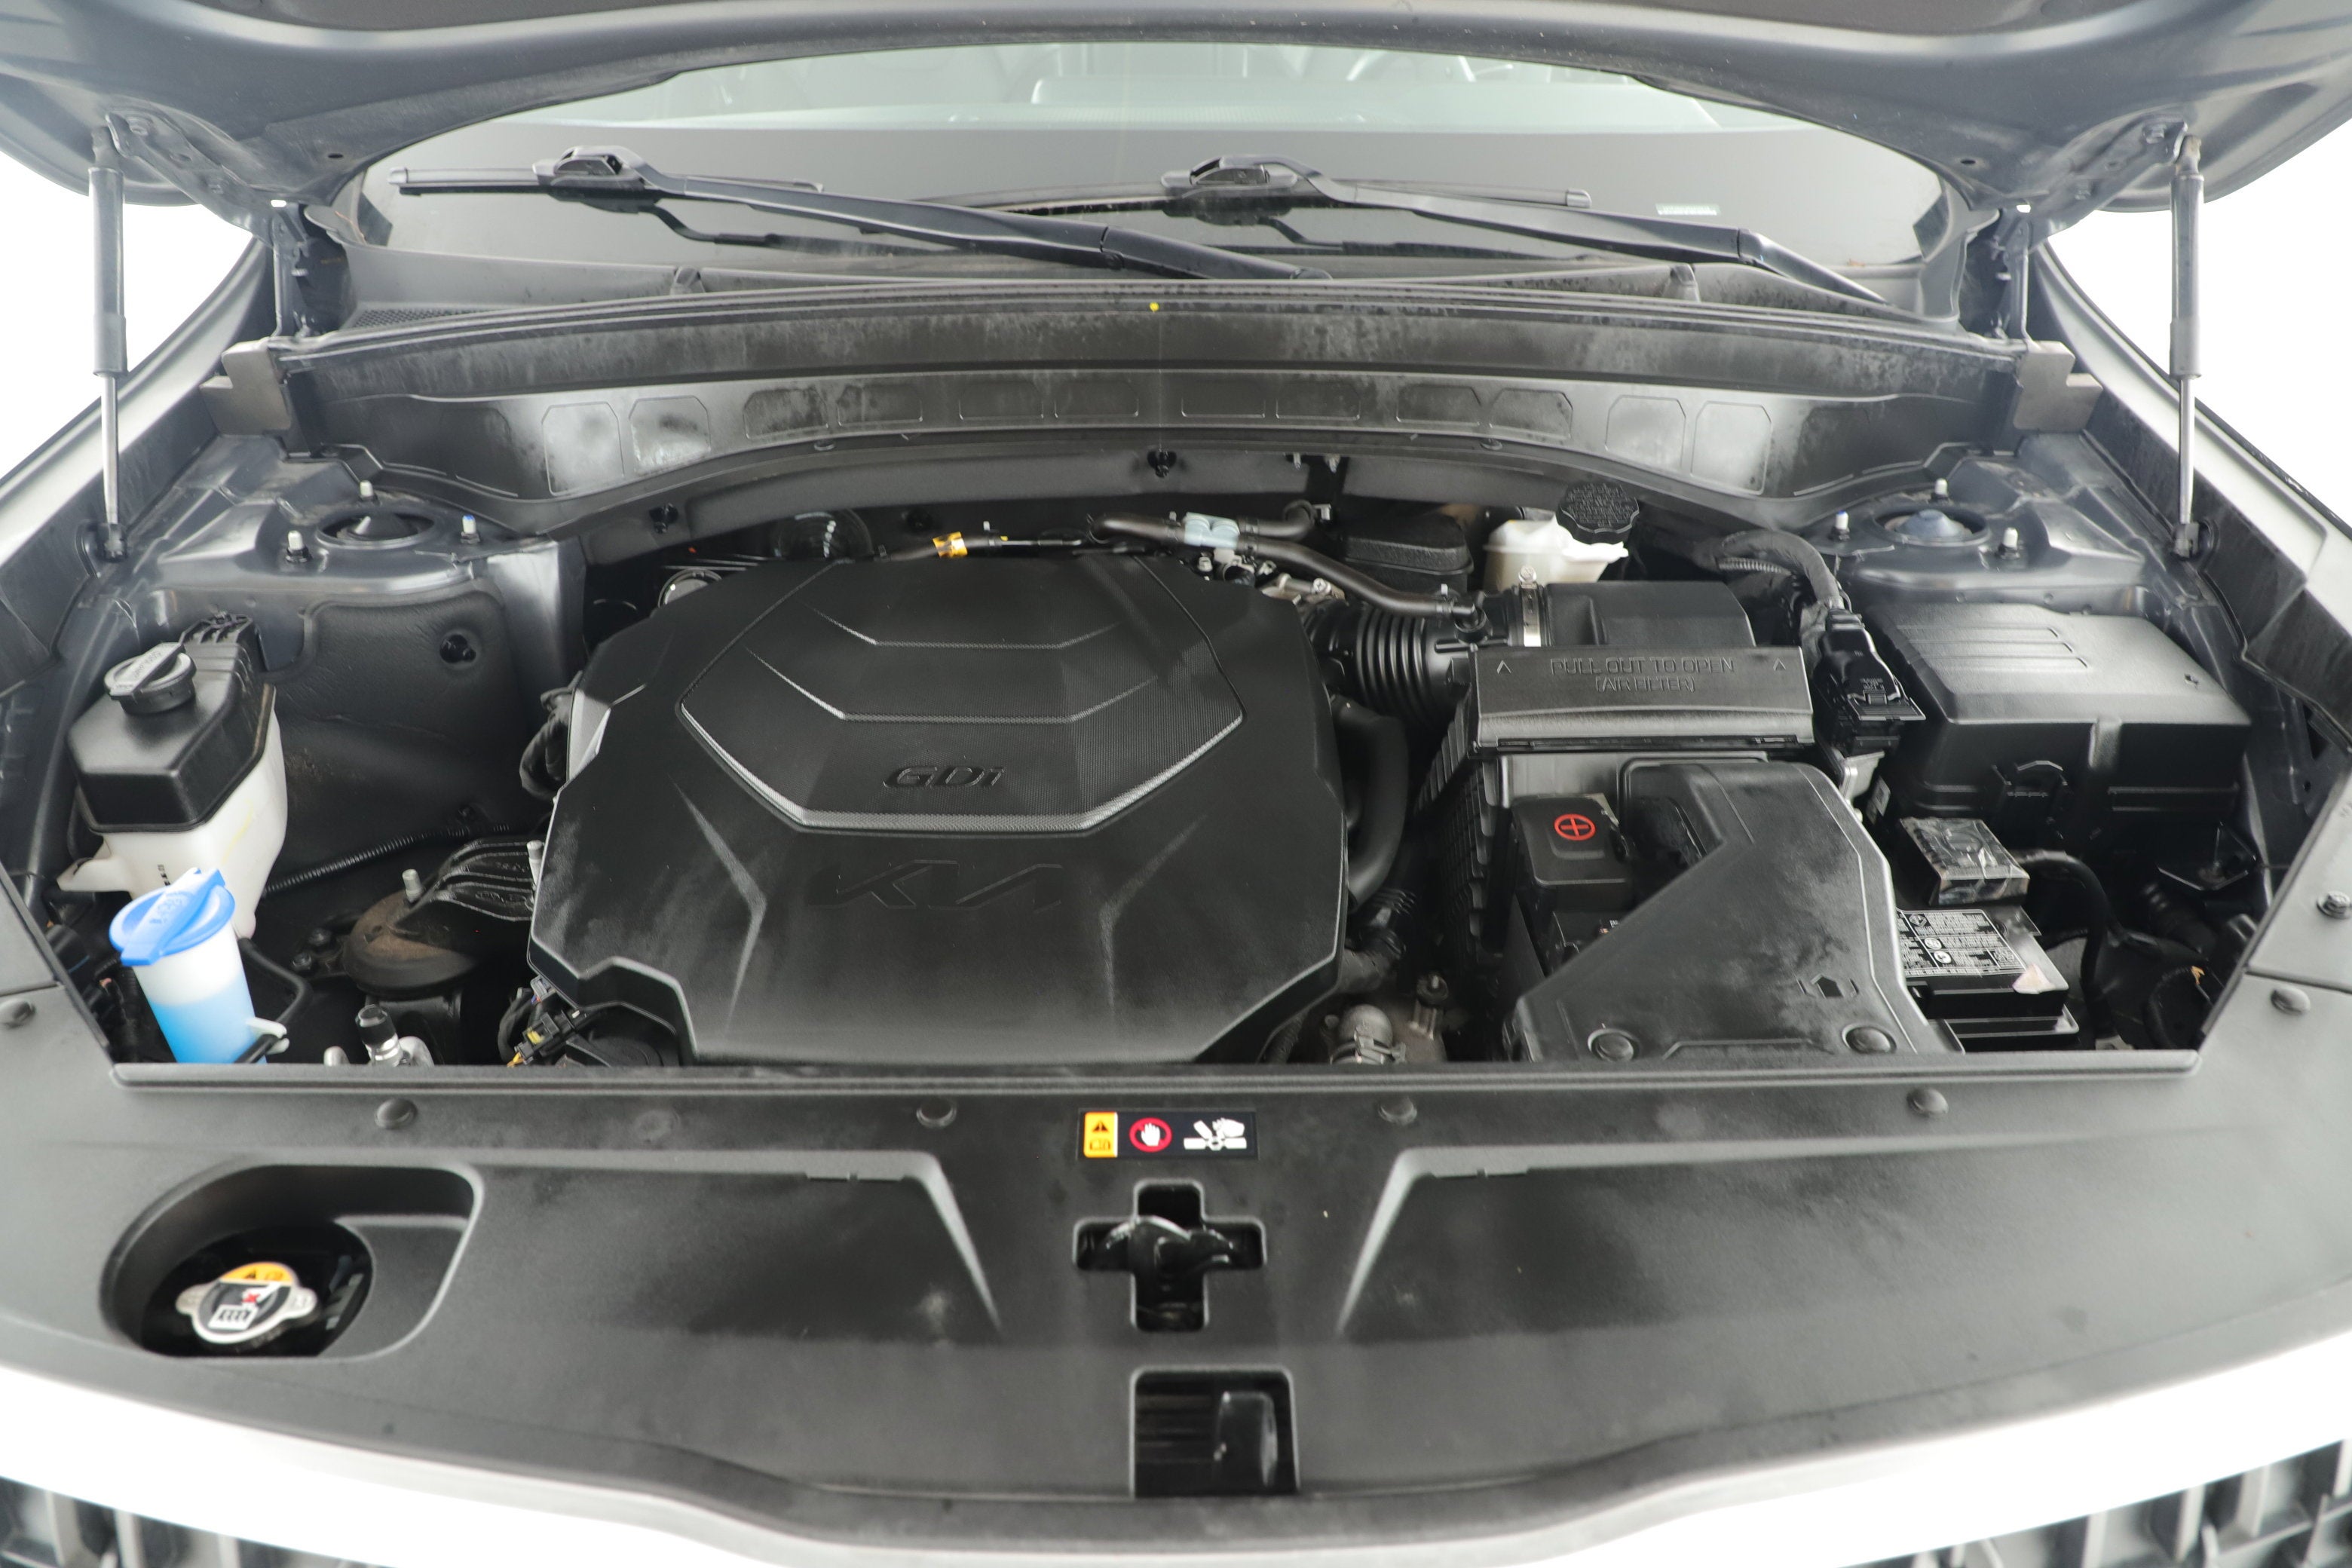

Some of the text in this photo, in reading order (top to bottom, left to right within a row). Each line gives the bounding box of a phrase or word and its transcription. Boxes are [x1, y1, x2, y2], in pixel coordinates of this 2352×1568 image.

[1550, 656, 1735, 675] PULL OUT TO OPEN
[807, 859, 1064, 914] KIA
